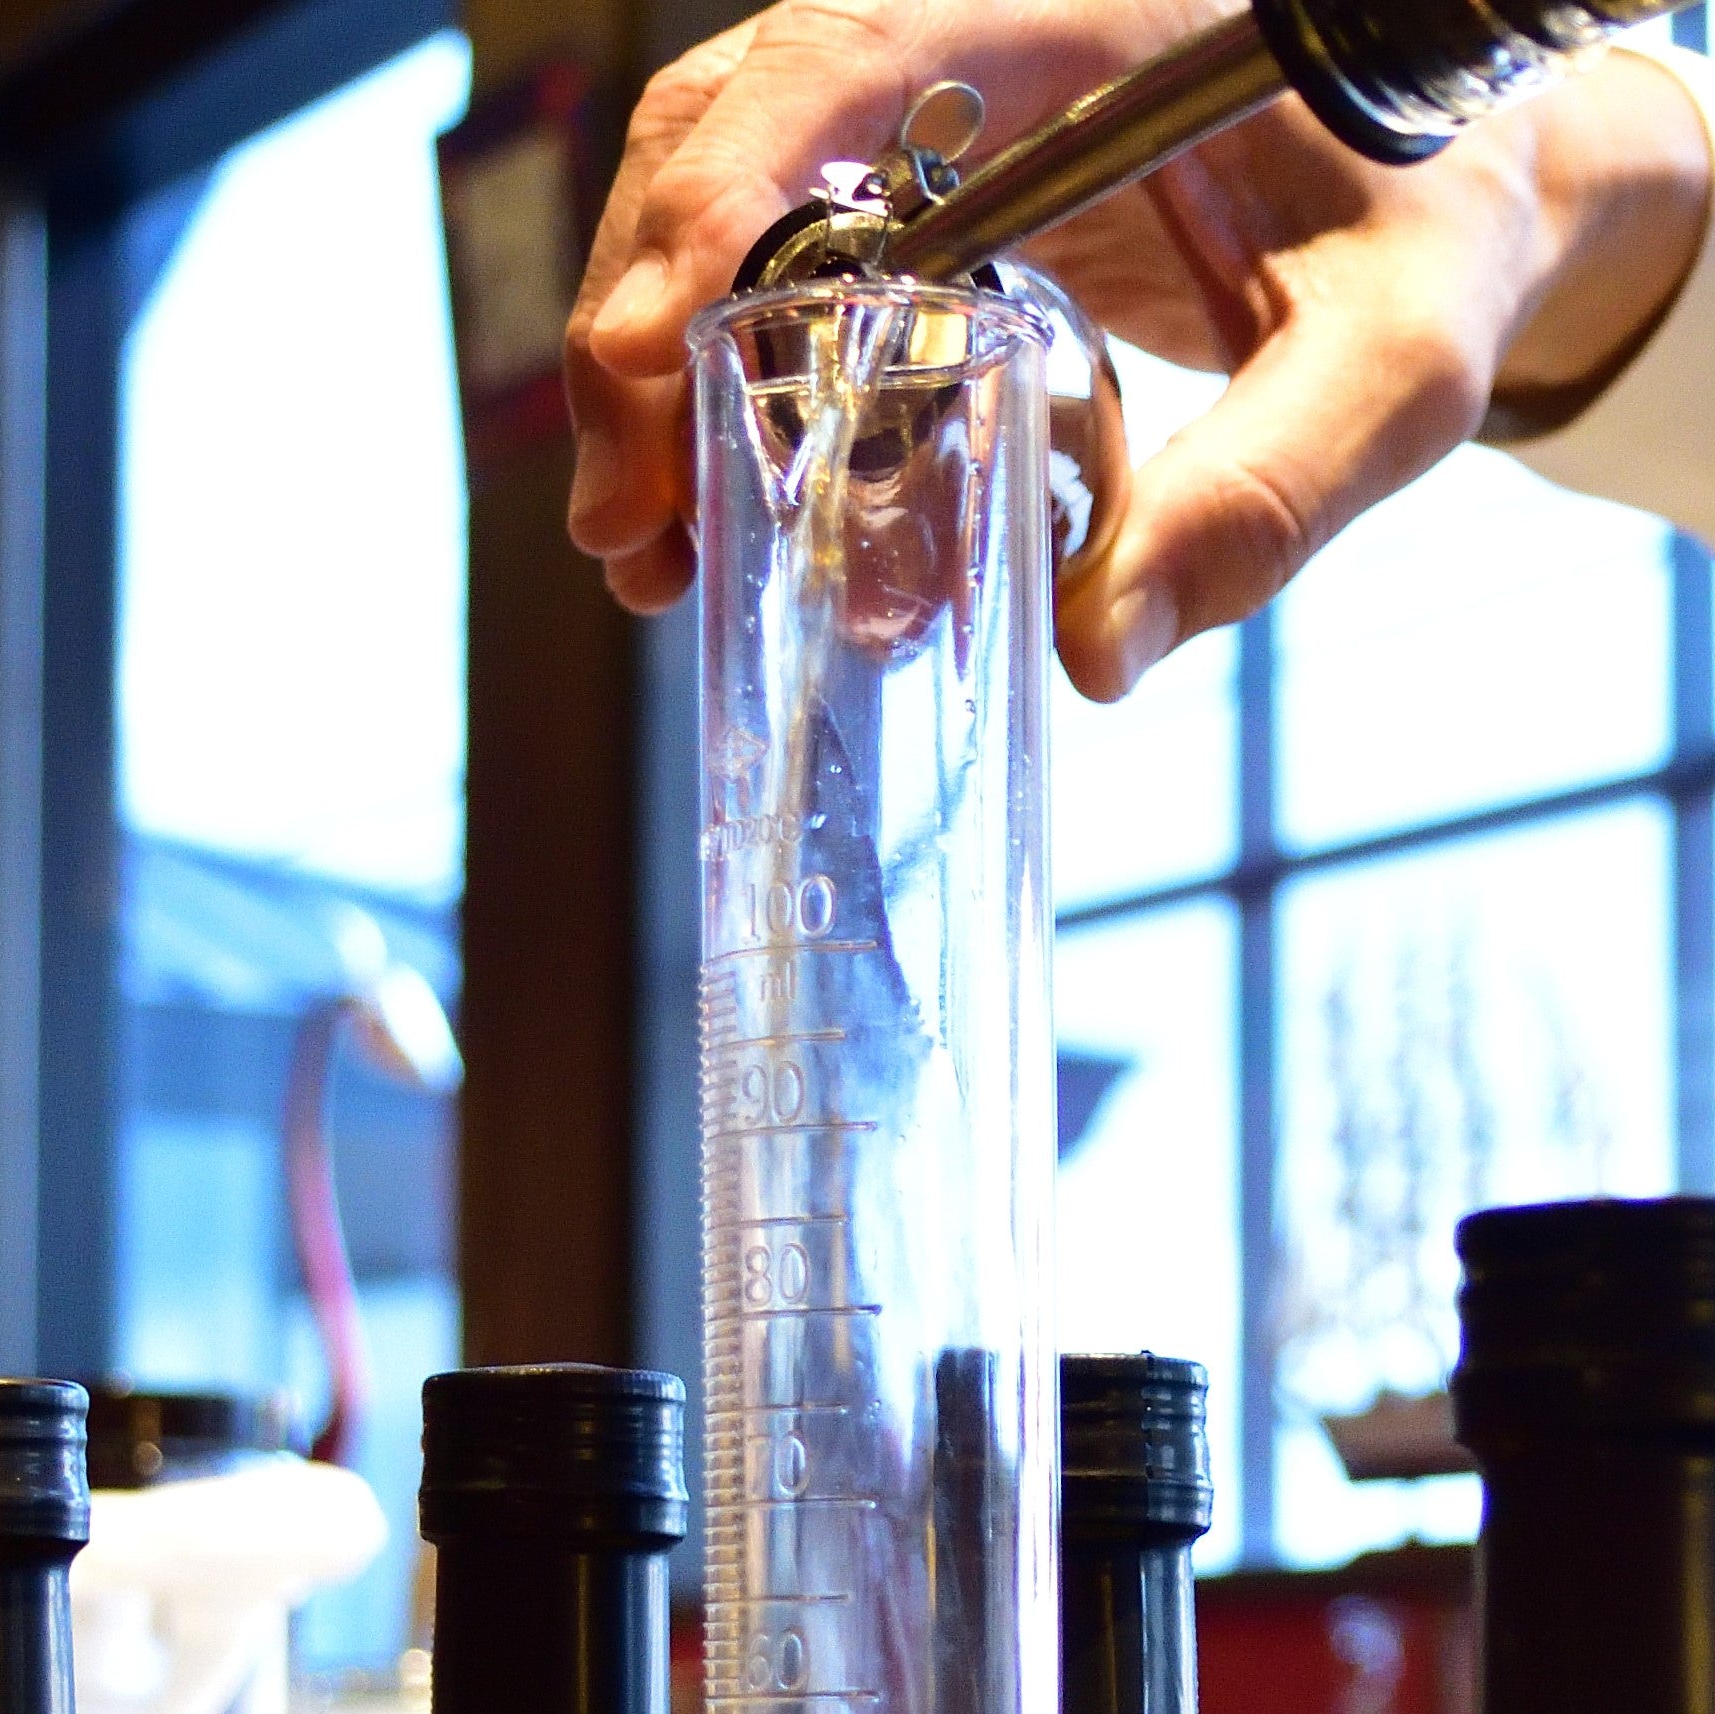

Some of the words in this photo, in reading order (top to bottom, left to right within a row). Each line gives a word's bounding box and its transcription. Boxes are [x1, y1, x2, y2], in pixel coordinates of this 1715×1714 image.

[747, 873, 838, 942] 100
[741, 1060, 805, 1125] 90
[745, 1243, 811, 1306] 80
[745, 1625, 811, 1690] 60
